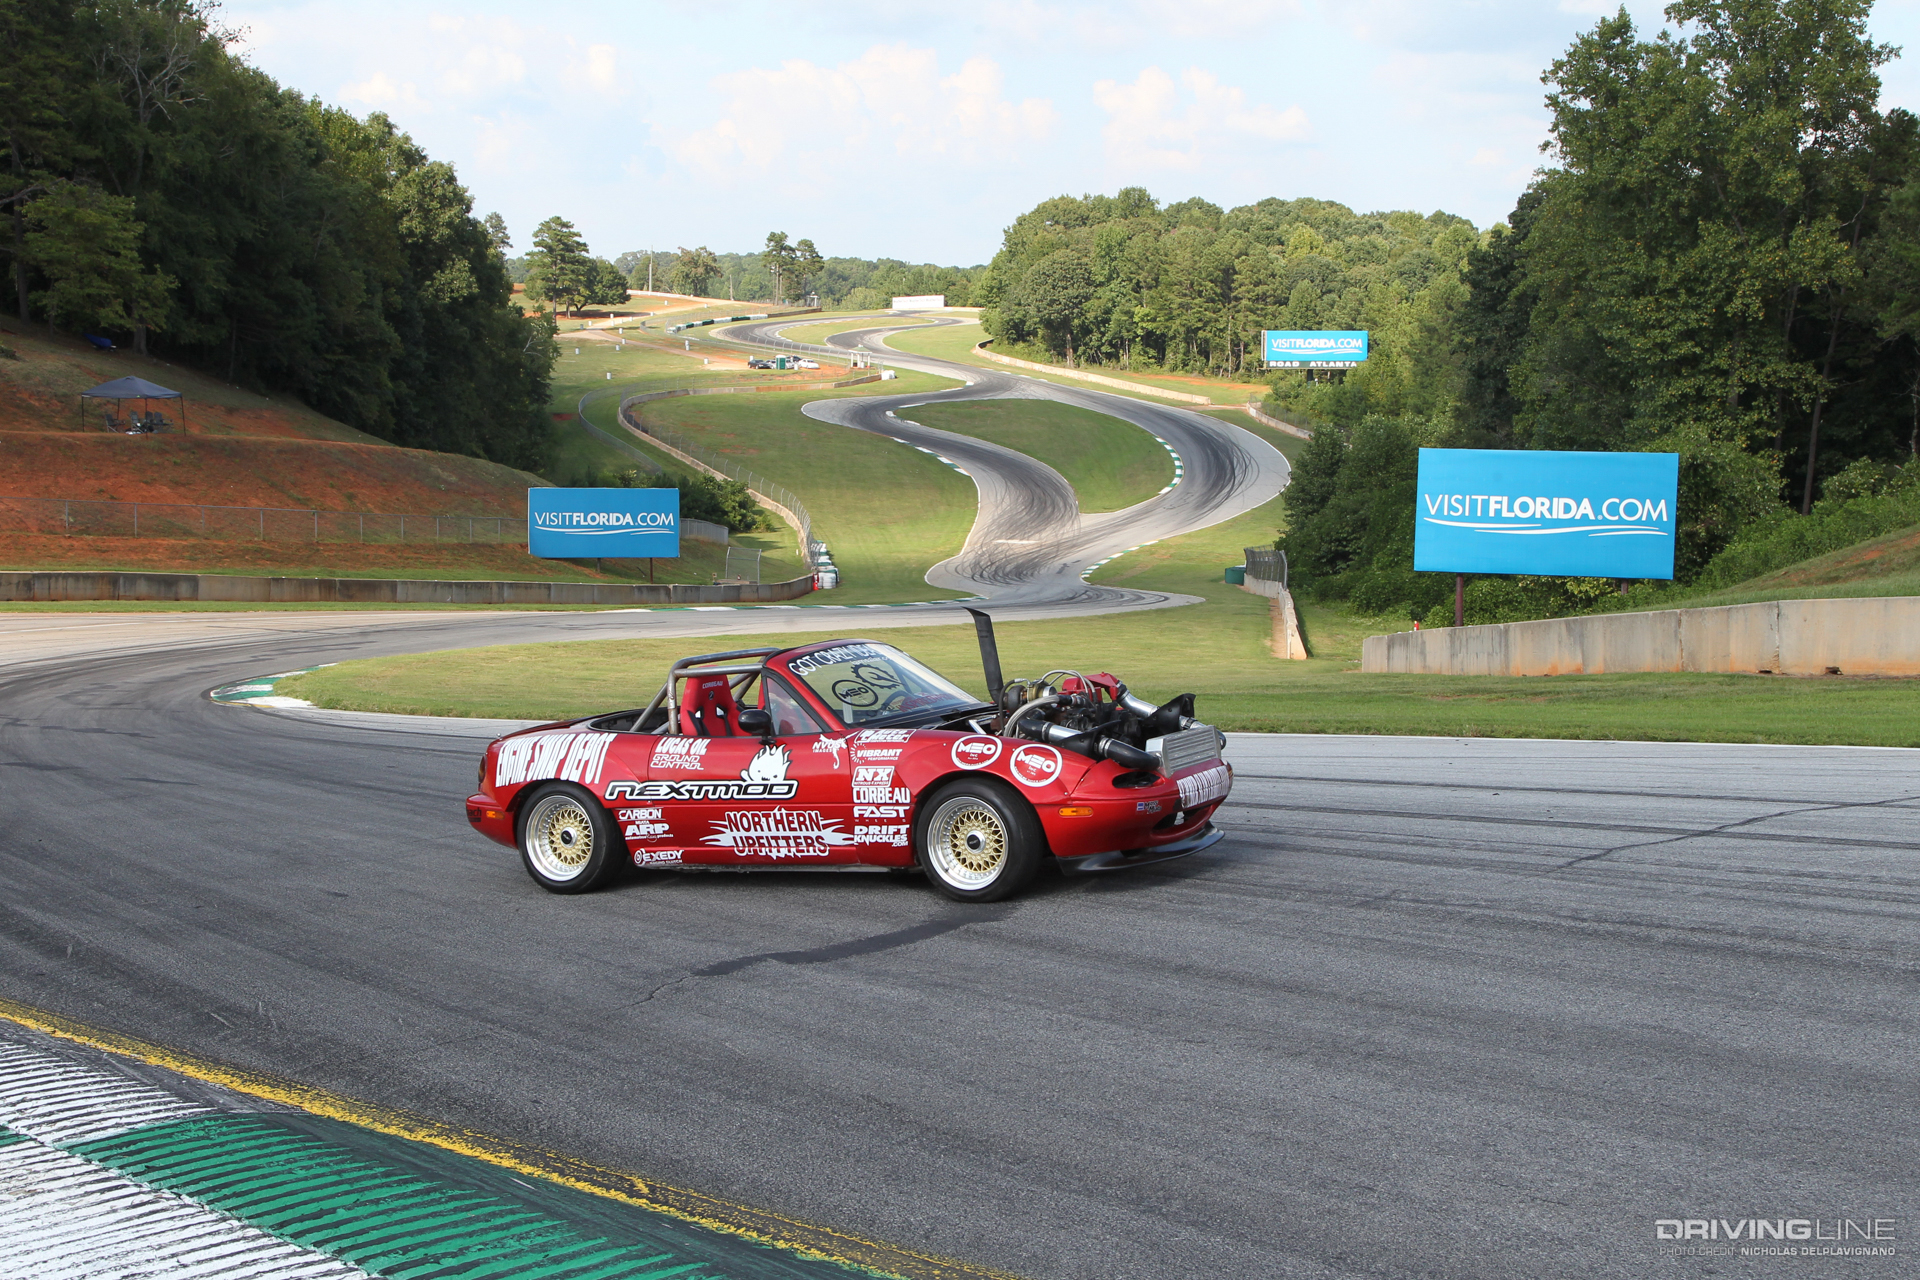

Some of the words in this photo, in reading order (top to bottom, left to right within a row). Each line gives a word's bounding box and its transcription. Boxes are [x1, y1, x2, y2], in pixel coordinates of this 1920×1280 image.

[1271, 338, 1363, 348] VISITFLORIDA.COM
[1424, 493, 1668, 522] VISITFLORIDA.COM
[534, 511, 674, 526] VISITFLORIDA.COM
[788, 655, 822, 676] GOT
[655, 737, 694, 755] LUCAS
[690, 738, 711, 755] OIL
[957, 741, 996, 755] MEO
[526, 733, 577, 782] SWAP
[560, 732, 618, 784] DEPOT
[652, 753, 700, 763] GROUND
[857, 749, 903, 757] VIBRANT
[650, 760, 705, 770] CONTROL
[1017, 750, 1056, 773] MEO
[856, 768, 893, 781] NX
[853, 787, 911, 803] CORBEAU
[618, 808, 662, 820] CARBON
[853, 805, 910, 818] FAST
[725, 810, 821, 832] NORTHERN
[625, 823, 670, 836] ARP
[854, 825, 910, 835] DRIFT
[732, 835, 829, 856] UPFITTERS
[854, 834, 908, 845] KNUCKLES
[643, 849, 684, 862] EXEDY
